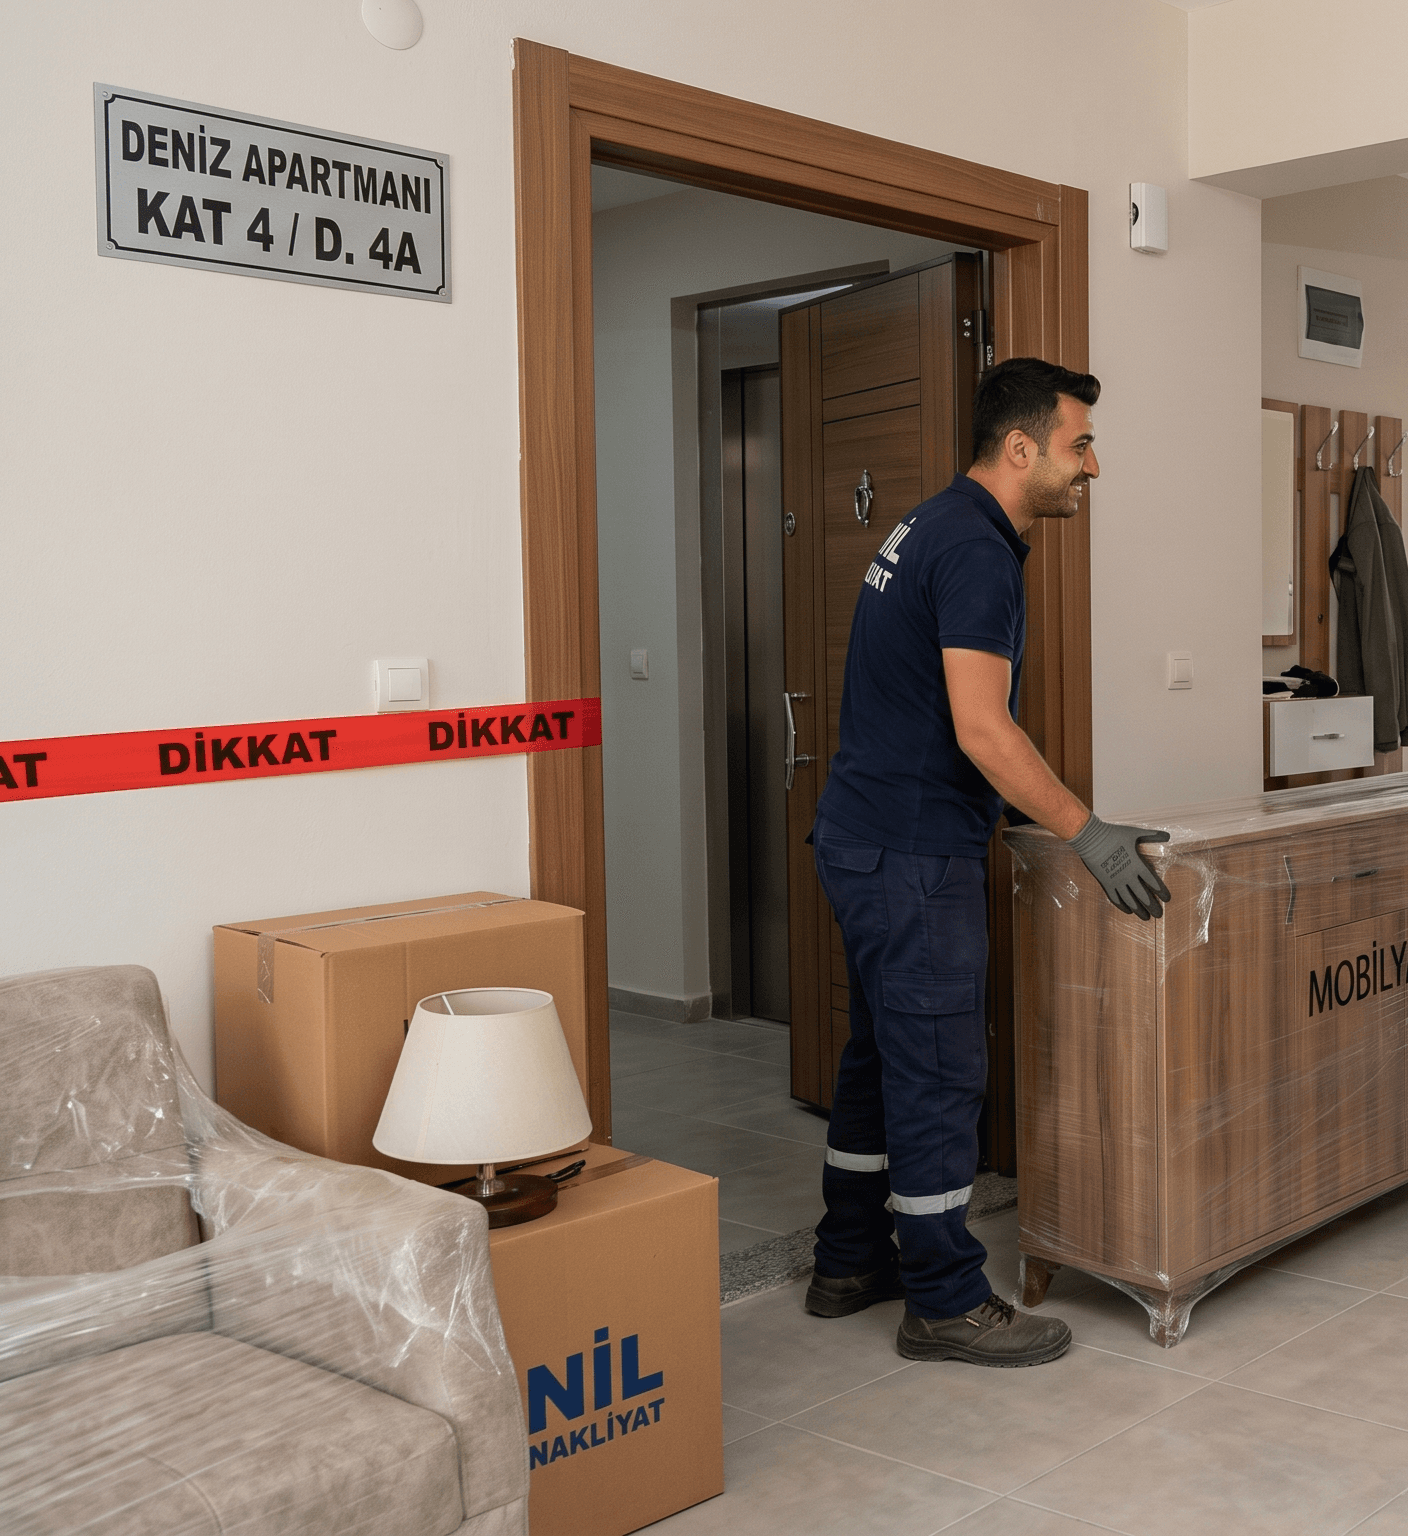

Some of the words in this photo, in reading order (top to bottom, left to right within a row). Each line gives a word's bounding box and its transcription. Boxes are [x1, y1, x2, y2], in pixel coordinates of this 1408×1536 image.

[121, 119, 232, 179] DENİZ
[242, 143, 432, 214] APARTMANI
[137, 188, 232, 246] KAT
[246, 207, 274, 253] 4
[288, 212, 300, 257] /
[314, 216, 354, 265] D.
[368, 227, 422, 275] 4A
[158, 731, 337, 776] DİKKAT
[428, 711, 576, 751] DİKKAT
[527, 1326, 664, 1435] NİL
[529, 1397, 666, 1471] NAKLİYAT
